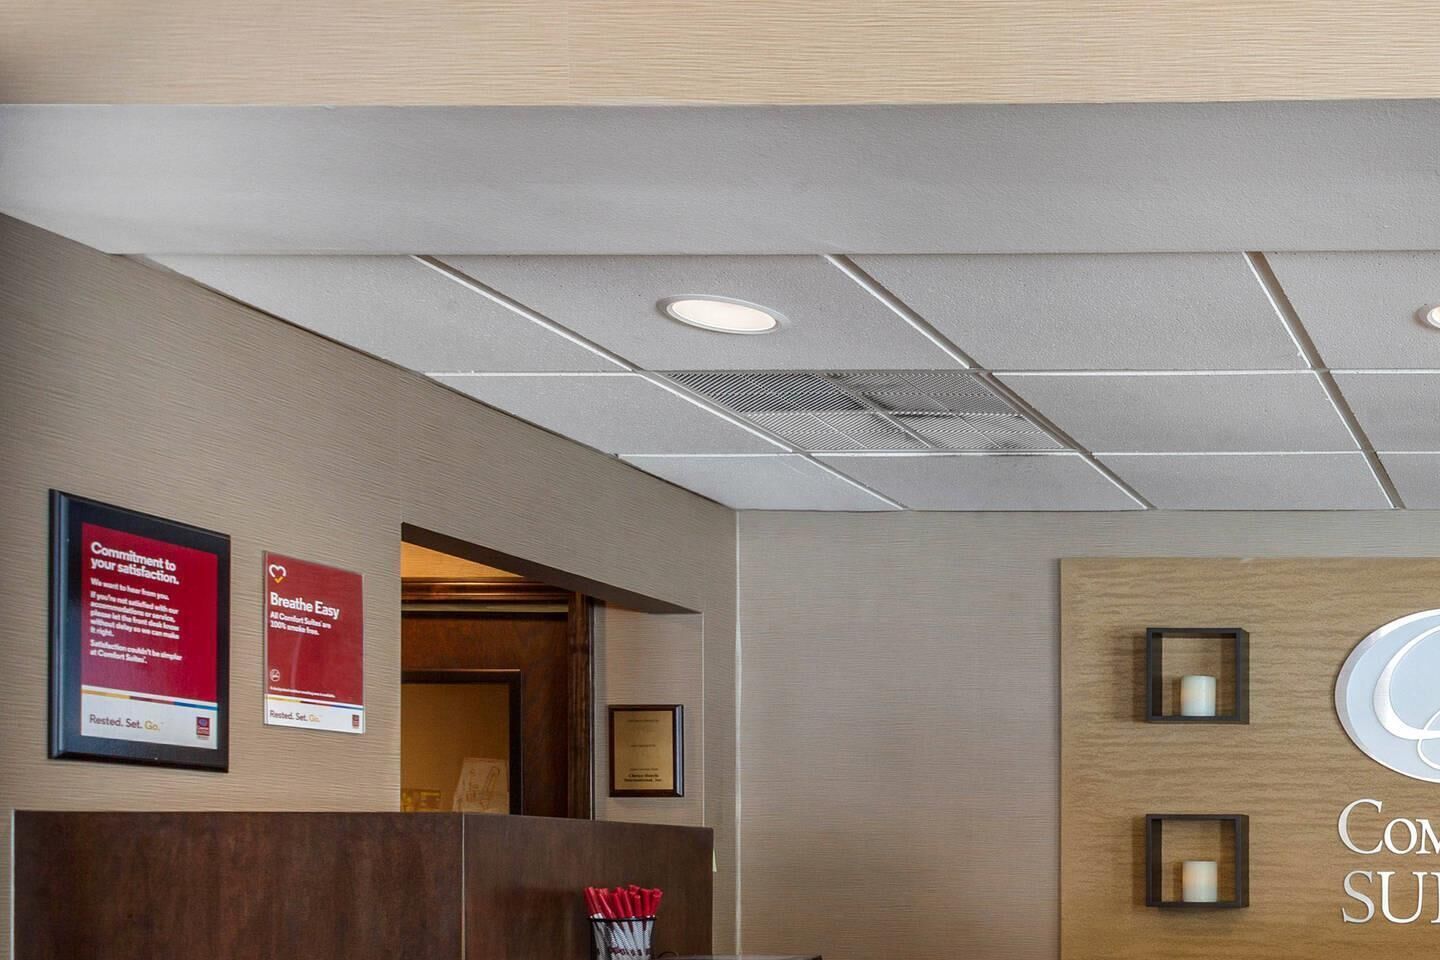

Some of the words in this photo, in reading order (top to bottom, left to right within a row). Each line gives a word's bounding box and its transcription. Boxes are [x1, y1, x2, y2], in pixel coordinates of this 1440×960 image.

[90, 541, 163, 569] Commitment
[164, 559, 176, 571] to
[90, 558, 116, 570] your
[117, 564, 179, 585] satisfaction.
[270, 591, 313, 613] Breathe
[314, 600, 340, 620] Easy
[89, 713, 123, 728] Rested.
[125, 718, 142, 729] Set.
[269, 709, 294, 720] Rested.
